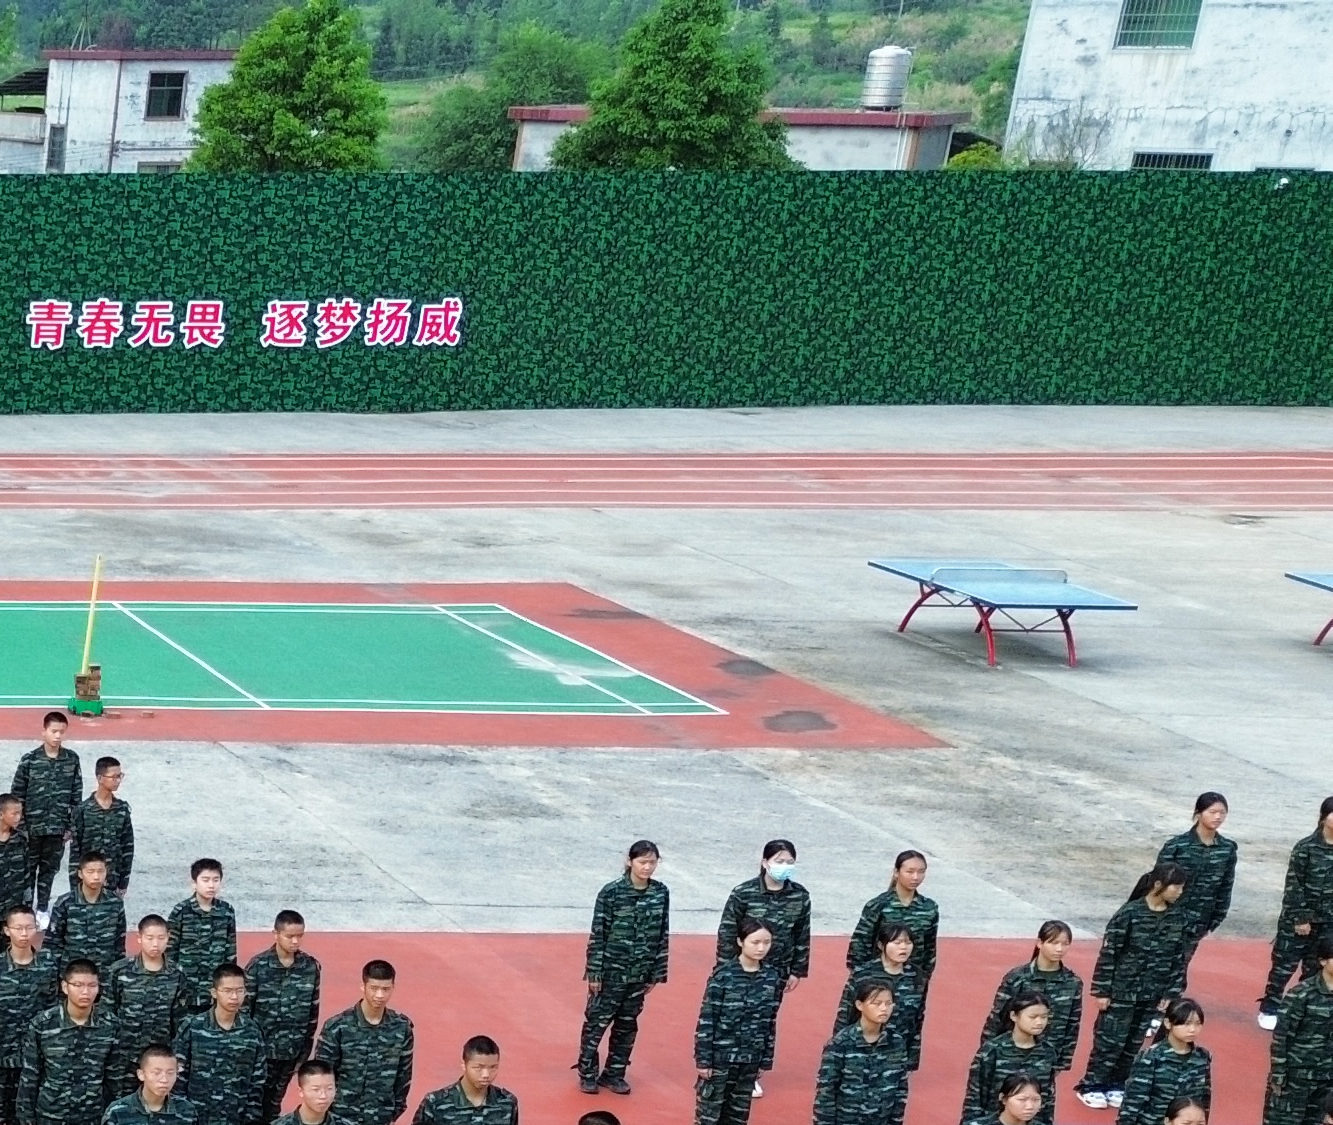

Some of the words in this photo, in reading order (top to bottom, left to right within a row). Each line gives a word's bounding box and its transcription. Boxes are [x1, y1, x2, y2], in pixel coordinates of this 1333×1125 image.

[26, 298, 225, 350] 青春无畏
[259, 298, 463, 348] 逐梦扬威
